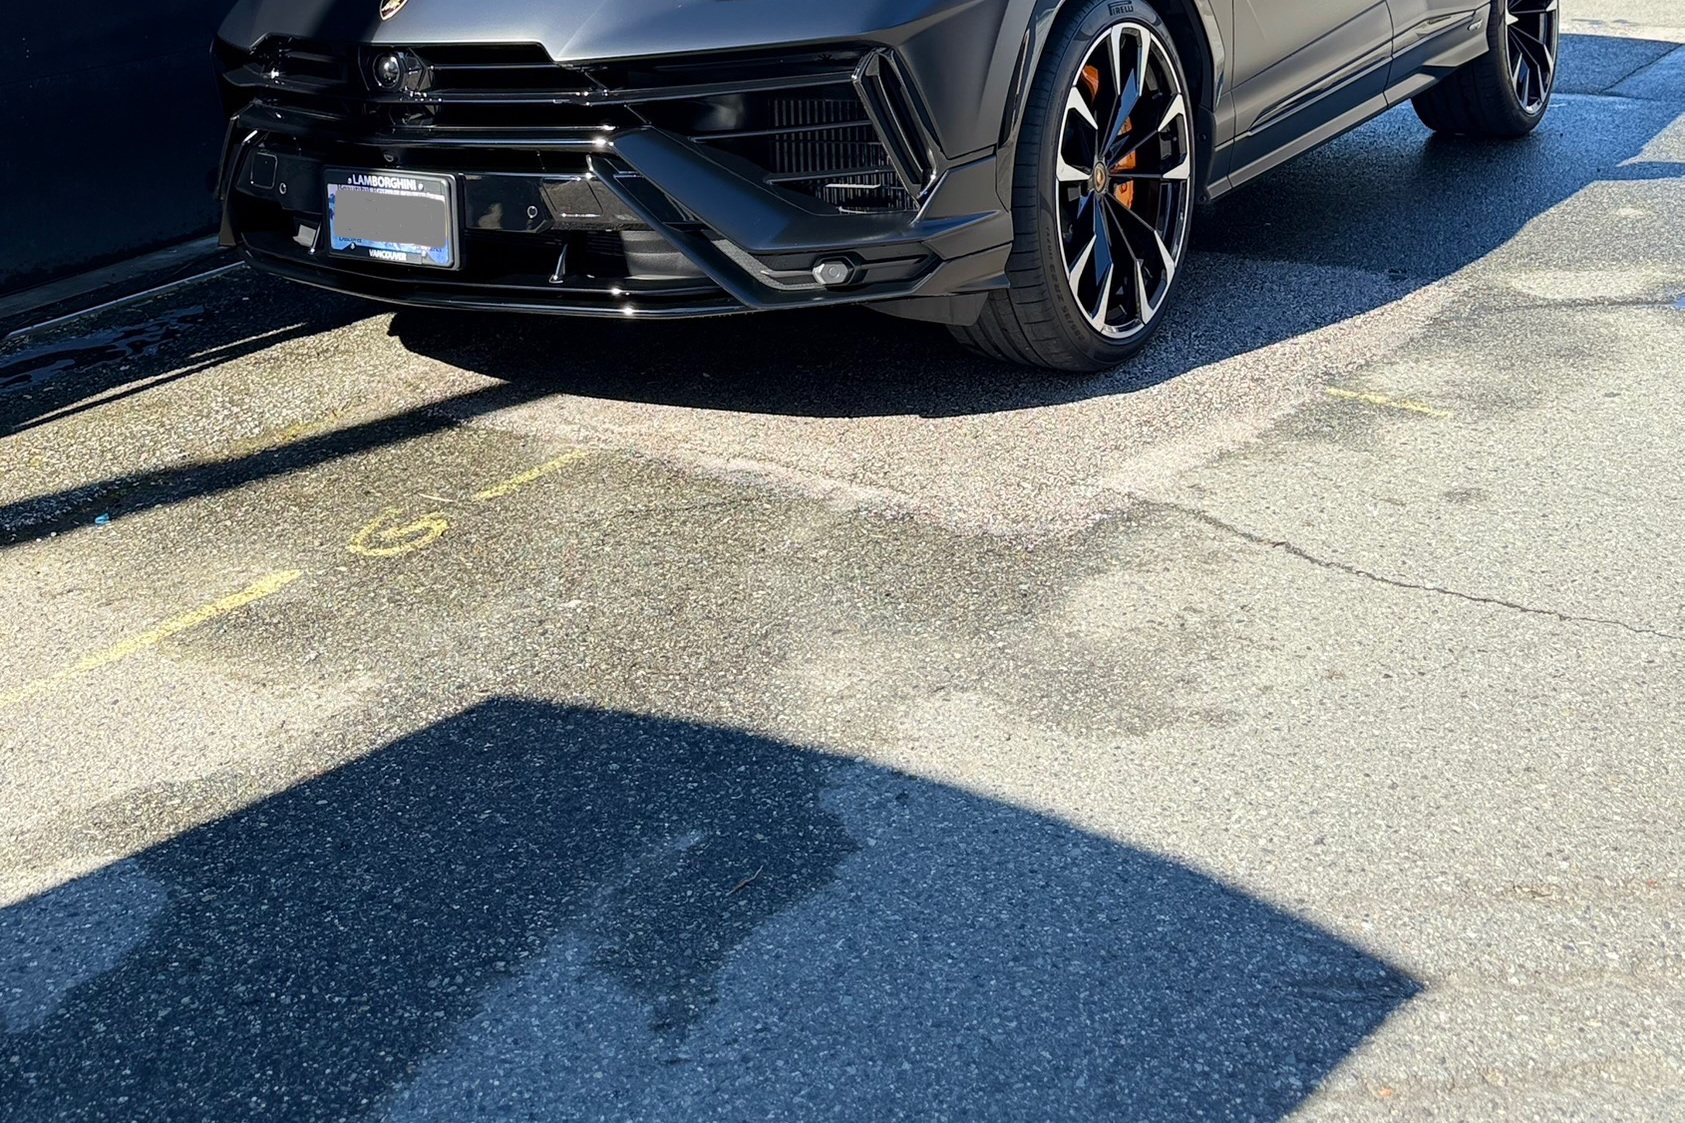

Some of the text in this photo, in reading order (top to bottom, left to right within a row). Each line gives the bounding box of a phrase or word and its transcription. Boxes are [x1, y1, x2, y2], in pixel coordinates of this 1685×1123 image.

[1107, 0, 1134, 16] PIRELLI
[352, 174, 417, 190] LAMBORGHINI
[369, 249, 407, 261] VANCOUVER
